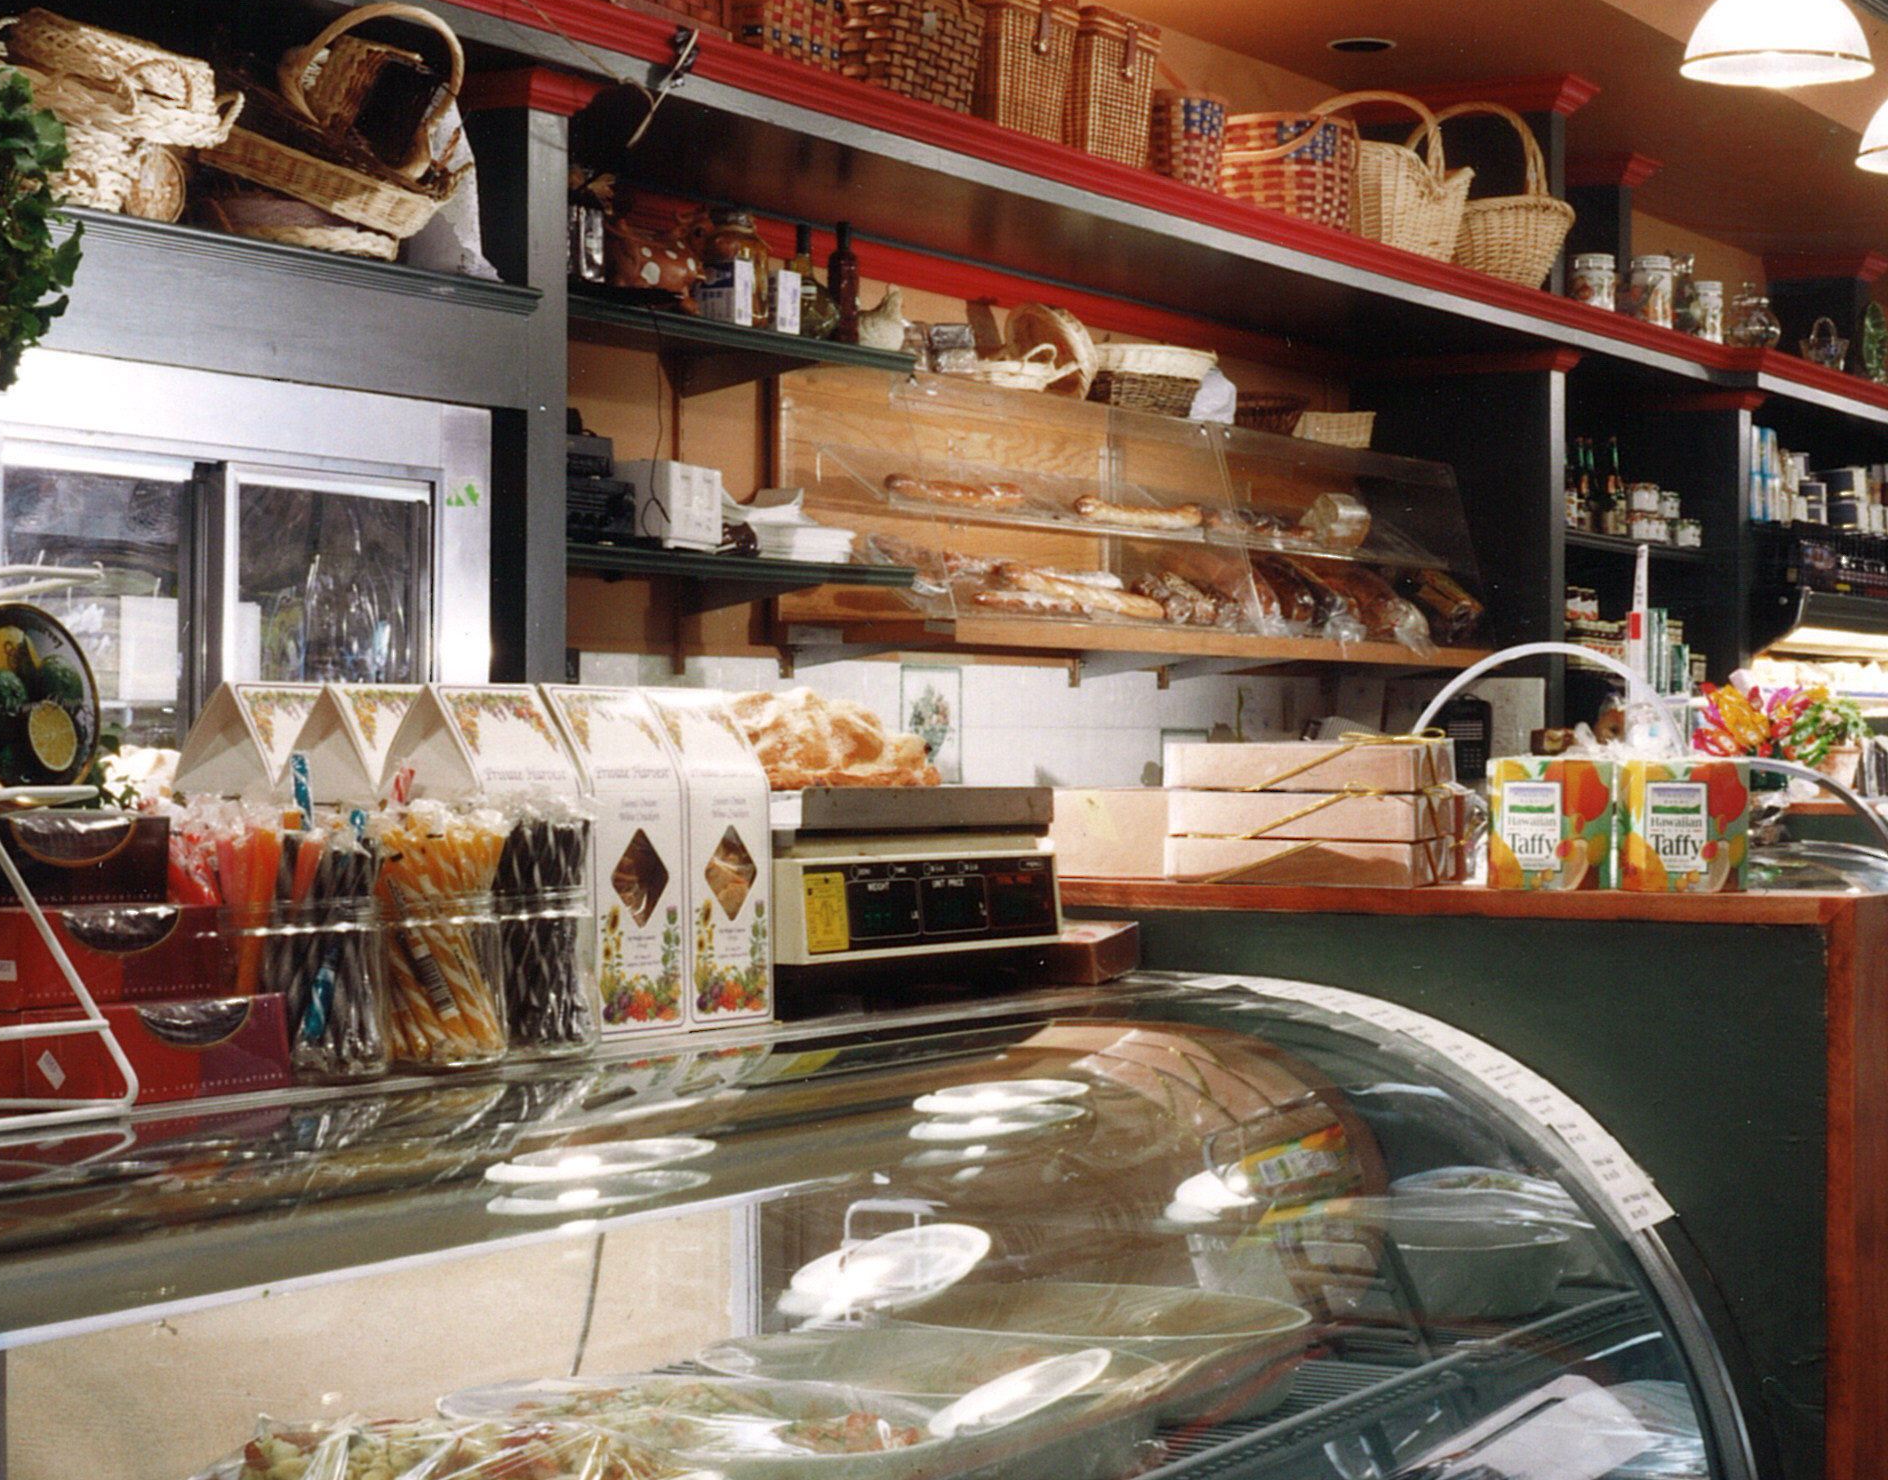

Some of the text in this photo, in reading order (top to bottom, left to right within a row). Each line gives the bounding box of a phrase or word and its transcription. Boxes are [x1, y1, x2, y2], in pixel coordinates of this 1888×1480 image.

[1507, 816, 1557, 827] Hawaiian
[1650, 816, 1702, 827] Hawaiian
[1507, 833, 1558, 859] Taffy
[1650, 833, 1704, 860] Taffy
